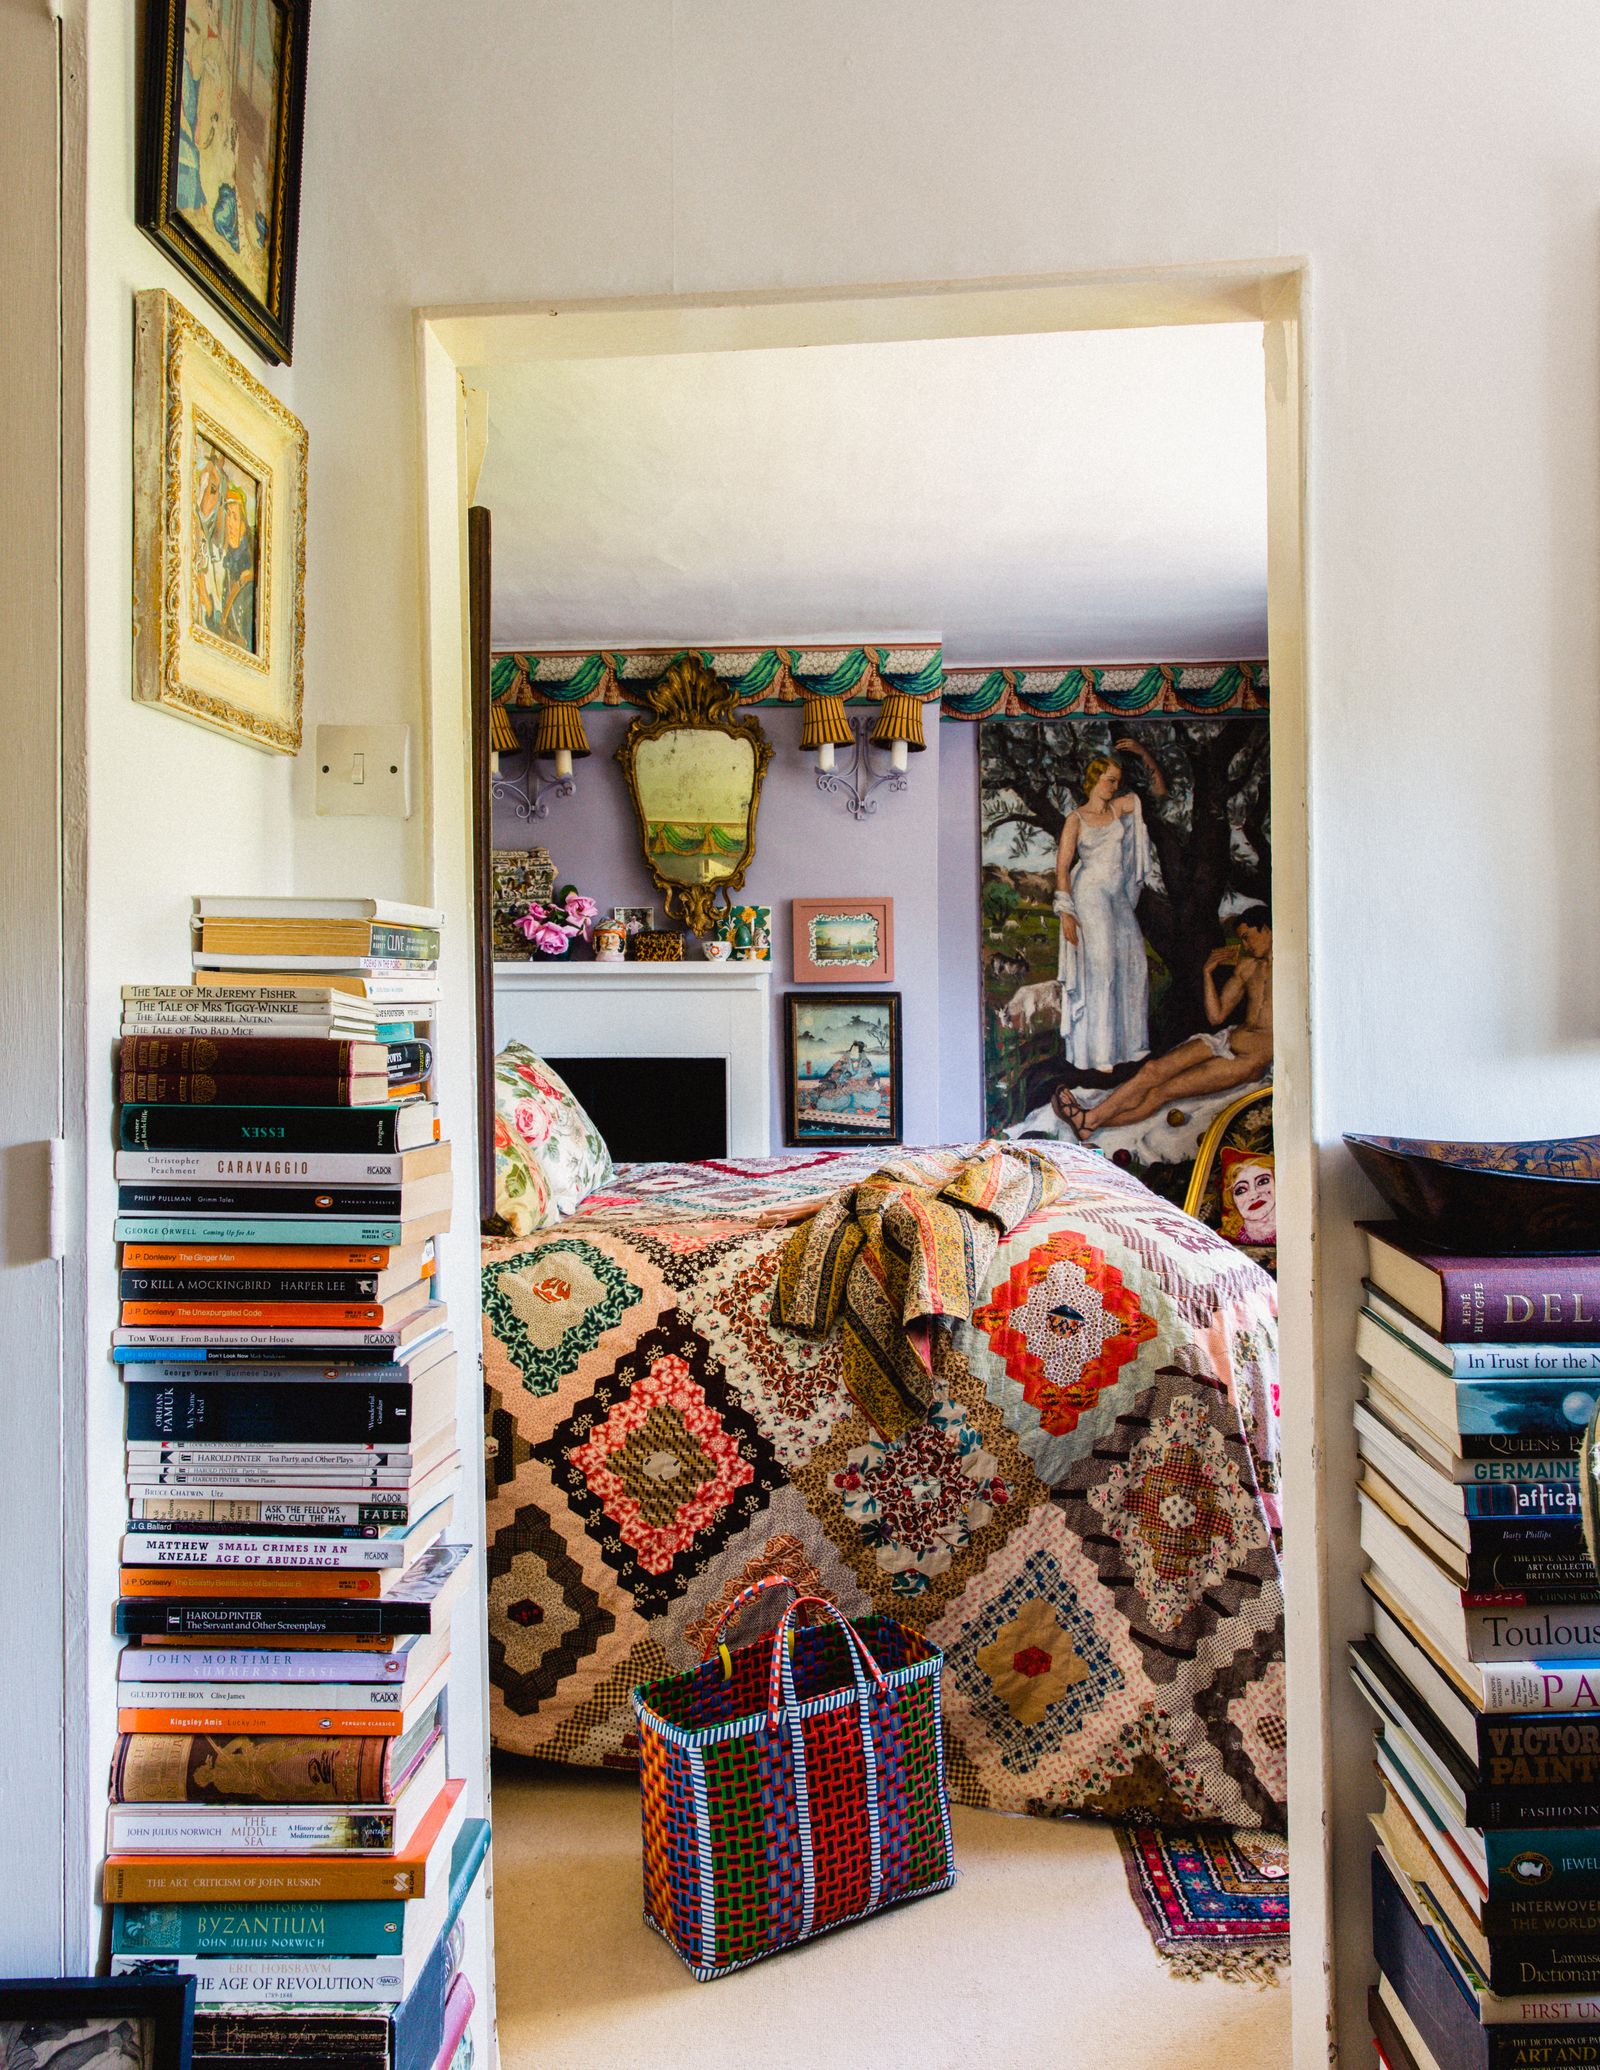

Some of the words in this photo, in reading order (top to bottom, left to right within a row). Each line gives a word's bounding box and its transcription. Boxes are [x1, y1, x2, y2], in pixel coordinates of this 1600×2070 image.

[136, 1001, 155, 1011] THE
[158, 1001, 183, 1012] TALE
[186, 1002, 199, 1012] OF
[202, 1002, 222, 1012] MRS
[225, 1002, 298, 1012] TIGGY-WINKLE
[136, 1013, 152, 1021] THE
[155, 1013, 177, 1022] TALE
[194, 1014, 236, 1024] SQUIRREL
[239, 1015, 273, 1023] NUTKIN
[132, 1025, 148, 1034] THE
[151, 1025, 173, 1034] TALE
[189, 1026, 208, 1035] TWO
[210, 1026, 228, 1035] BAD
[231, 1026, 254, 1035] MICE
[241, 1127, 285, 1138] ESSEX
[148, 1157, 199, 1166] Christopher
[151, 1166, 196, 1174] Peachment
[218, 1160, 308, 1174] CARAVAGGIO
[367, 1166, 391, 1174] PICADOR
[125, 1227, 159, 1235] GEORGE
[203, 1229, 224, 1237] Coming
[132, 1280, 148, 1289] TO
[151, 1280, 174, 1289] KILL
[177, 1281, 185, 1289] A
[188, 1281, 271, 1290] MOCKINGBIRD
[281, 1281, 324, 1290] HARPER
[327, 1282, 346, 1291] LEE
[1461, 1293, 1471, 1325] RENÉ
[1474, 1282, 1485, 1333] HUYGHE
[1504, 1293, 1600, 1324] DEL
[204, 1335, 238, 1343] Bauhaus
[364, 1335, 395, 1344] PICADOR
[1468, 1353, 1484, 1369] In
[1487, 1353, 1529, 1369] Trust
[1535, 1353, 1558, 1368] for
[1563, 1353, 1587, 1368] the
[164, 1388, 174, 1432] PAMUK
[281, 1456, 299, 1465] Party
[336, 1457, 354, 1465] Plays
[1474, 1462, 1580, 1480] GERMAINE
[144, 1488, 167, 1496] BRUCE
[170, 1489, 204, 1497] CHATWIN
[371, 1493, 402, 1502] PICADOR
[265, 1506, 282, 1514] ASK
[286, 1506, 301, 1514] THE
[304, 1506, 340, 1514] FELLOWS
[363, 1509, 407, 1520] FABER
[265, 1514, 286, 1522] WHO
[289, 1514, 306, 1522] CUT
[309, 1514, 324, 1522] THE
[328, 1515, 347, 1523] HAY
[1525, 1531, 1552, 1541] Phillips
[146, 1541, 209, 1550] MATTHEW
[218, 1543, 257, 1551] SMALL
[263, 1544, 309, 1552] CRIMES
[158, 1553, 208, 1561] KNEALE
[216, 1555, 239, 1563] AGE
[267, 1557, 340, 1565] ABUNDANCE
[364, 1552, 389, 1560] PICADOR
[186, 1612, 227, 1620] HAROLD
[229, 1612, 262, 1620] PINTER
[186, 1621, 202, 1629] The
[204, 1621, 234, 1629] Servant
[235, 1621, 250, 1629] and
[252, 1621, 276, 1629] Other
[278, 1621, 326, 1632] Screenplays
[149, 1655, 193, 1665] JOHN
[202, 1655, 292, 1664] MORTIMER
[193, 1666, 278, 1676] SUMMER'S
[288, 1668, 337, 1677] LEASE
[371, 1692, 399, 1702] PICADOR
[170, 1718, 202, 1726] Kingsley
[243, 1817, 267, 1826] THE
[127, 1829, 150, 1837] JOHN
[231, 1827, 277, 1837] MIDDLE
[244, 1837, 264, 1846] SEA
[147, 1879, 166, 1887] THE
[169, 1879, 189, 1887] ART
[193, 1879, 241, 1887] CRITICISM
[244, 1879, 257, 1887] OF
[258, 1879, 284, 1887] JOHN
[198, 1918, 325, 1934] BYZANTIUM
[197, 1939, 227, 1947] JOHN
[231, 1939, 268, 1947] JULIUS
[271, 1938, 325, 1948] NORWICH
[196, 1978, 215, 1990] HE
[219, 1978, 249, 1990] AGE
[253, 1978, 273, 1990] OF
[277, 1978, 374, 1990] REVOLUTION
[1521, 2003, 1571, 2019] FIRST
[1530, 2037, 1576, 2047] DICTIONARY
[1515, 2050, 1554, 2064] ART
[1556, 2048, 1597, 2063] AND
